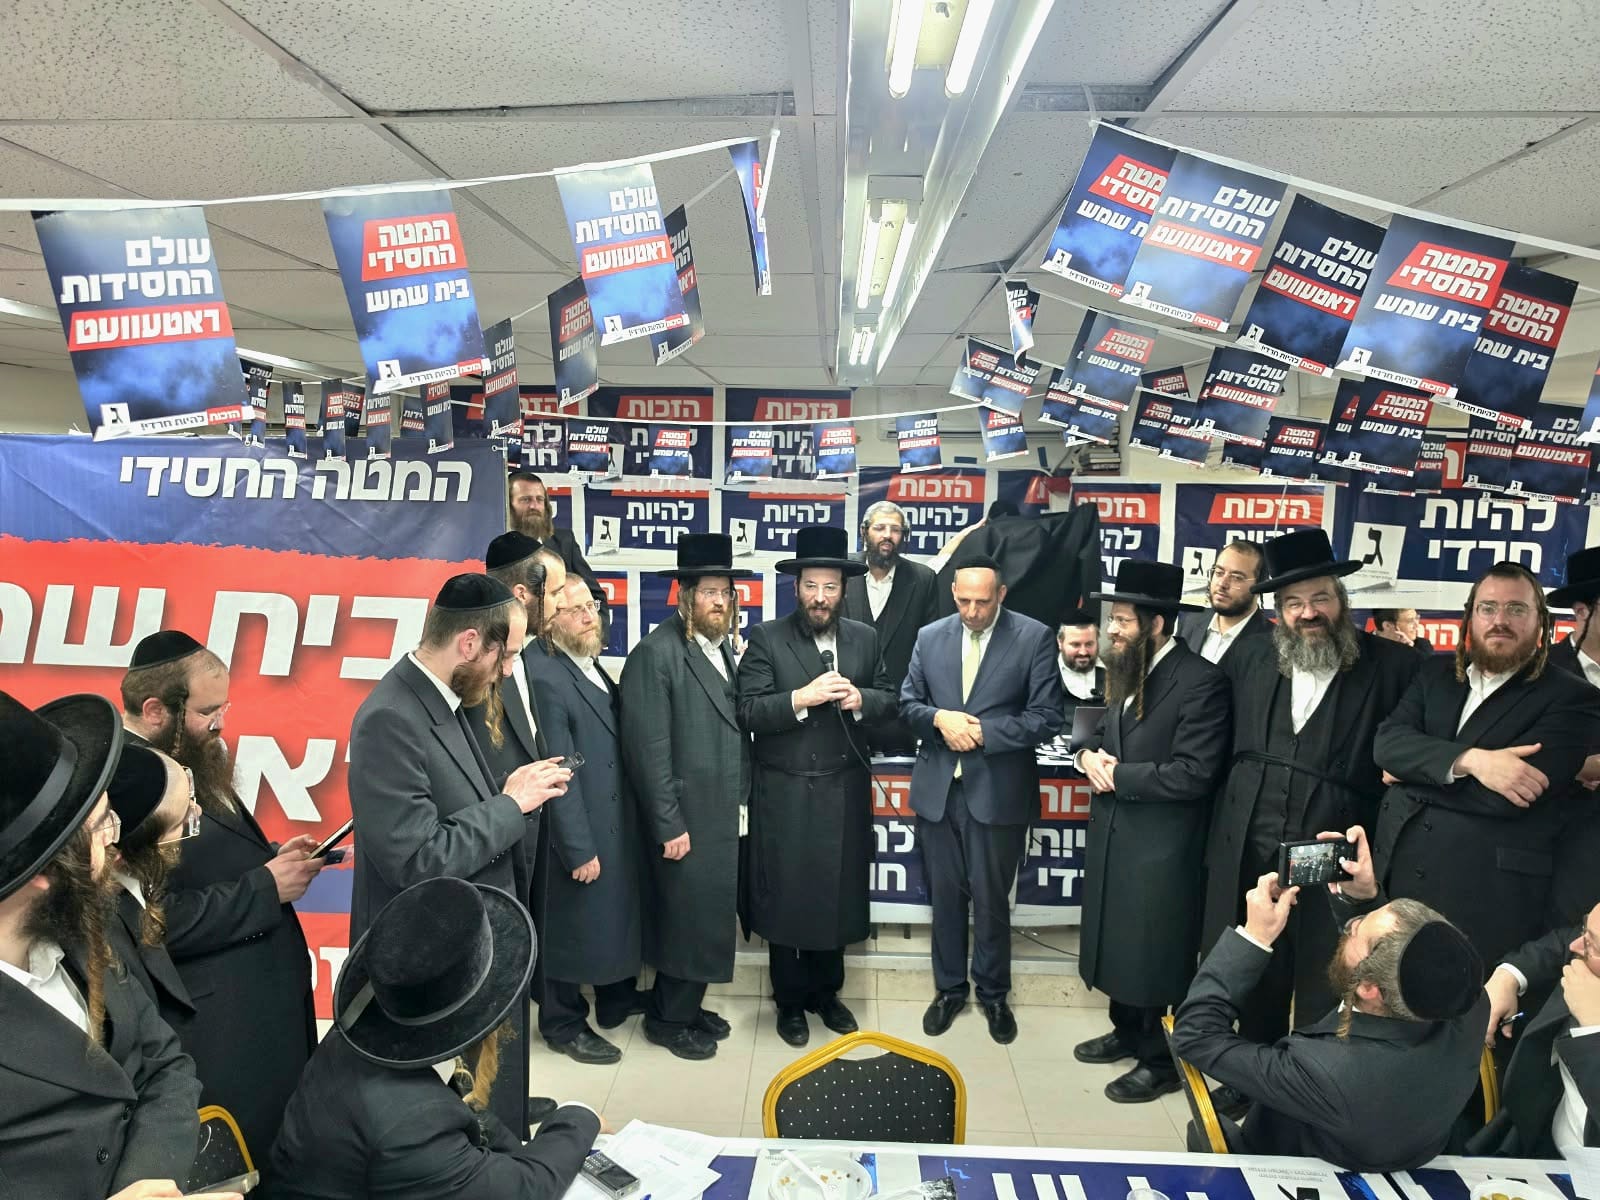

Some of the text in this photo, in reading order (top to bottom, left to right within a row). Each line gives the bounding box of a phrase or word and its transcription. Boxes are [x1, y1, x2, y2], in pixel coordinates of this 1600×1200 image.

[1117, 162, 1168, 192] מטה
[608, 186, 658, 213] עולם
[1101, 175, 1161, 211] חסידי
[1212, 185, 1281, 218] עולם
[575, 210, 663, 244] החסידות
[1076, 199, 1132, 231] שמש
[1159, 196, 1267, 240] החסידות
[378, 219, 451, 248] המטה
[125, 236, 211, 267] עולם
[368, 243, 457, 273] החסידי
[585, 240, 668, 274] ראטעוועט
[1150, 225, 1253, 267] ראטעוועט
[1321, 236, 1378, 270] עולם
[1274, 241, 1368, 291] החסידות
[1419, 248, 1497, 281] המטה
[61, 269, 214, 304] החסידות
[1266, 268, 1357, 315] ראטעוועט
[1400, 265, 1489, 302] החסידי
[365, 278, 471, 314] בית שמש
[565, 296, 590, 322] המטה
[1373, 293, 1483, 333] בית שמש
[1497, 293, 1561, 325] המטה
[75, 308, 221, 345] ראטעוועט
[561, 311, 592, 336] החסידי
[1488, 309, 1555, 342] החסיד
[494, 335, 515, 357] עולם
[1100, 340, 1145, 361] החסידי
[1110, 331, 1149, 350] המטה
[1087, 354, 1142, 377] בית שמש
[1473, 336, 1551, 371] בית שמ
[994, 366, 1034, 385] החסידות
[1215, 369, 1280, 393] החסידות
[1247, 363, 1288, 381] עולם
[628, 399, 701, 418] הזכות
[1151, 403, 1173, 413] מטה
[1211, 385, 1274, 408] ראטעוועט
[1383, 394, 1429, 410] המטה
[765, 401, 839, 420] הזכות
[1145, 409, 1171, 420] חסידי
[1372, 403, 1426, 422] החסידי
[585, 425, 610, 434] עולם
[913, 418, 938, 428] עולם
[1284, 427, 1316, 438] המטה
[1359, 420, 1398, 436] שמש
[1398, 427, 1424, 440] בית
[568, 432, 608, 443] החסידות
[731, 438, 772, 447] החסידות
[1278, 434, 1315, 446] החסידי
[1469, 427, 1516, 445] חסידות
[1269, 446, 1314, 459] בית שמש
[1515, 444, 1587, 464] ראטעוועט
[119, 455, 473, 502] המטה החסידי
[898, 477, 973, 499] הזכות
[626, 500, 696, 521] להיות
[762, 503, 831, 524] להיות
[905, 505, 969, 527] להיות
[1222, 498, 1312, 520] הזכות
[1420, 497, 1558, 532] להיות
[600, 518, 612, 542] ג
[631, 525, 691, 545] חרדי
[735, 521, 748, 544] ג
[1362, 526, 1384, 567] ג
[1428, 539, 1543, 574] חרדי
[1190, 550, 1204, 576] ג
[205, 590, 430, 681] בית
